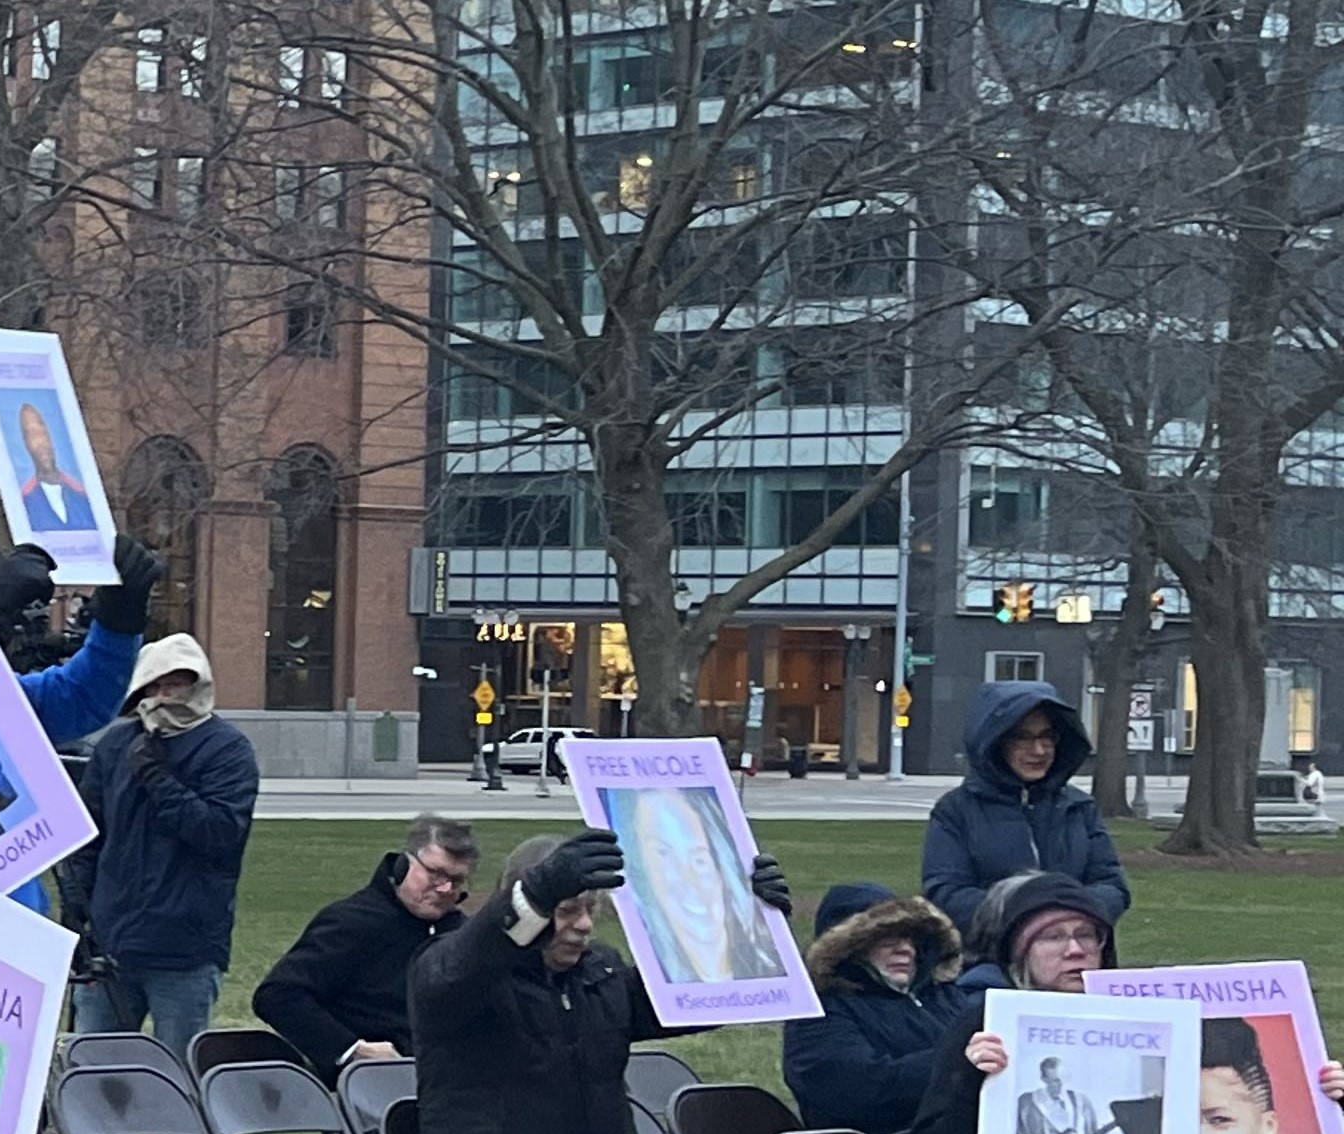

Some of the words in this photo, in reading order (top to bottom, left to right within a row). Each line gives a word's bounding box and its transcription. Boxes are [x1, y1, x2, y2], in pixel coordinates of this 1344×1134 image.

[586, 755, 630, 777] FREE
[630, 754, 706, 776] NICOLE
[675, 988, 792, 1011] #SecondLookMI
[1171, 978, 1287, 1003] TANISHA
[1027, 1027, 1076, 1046] FREE
[1082, 1029, 1161, 1051] CHUCK
